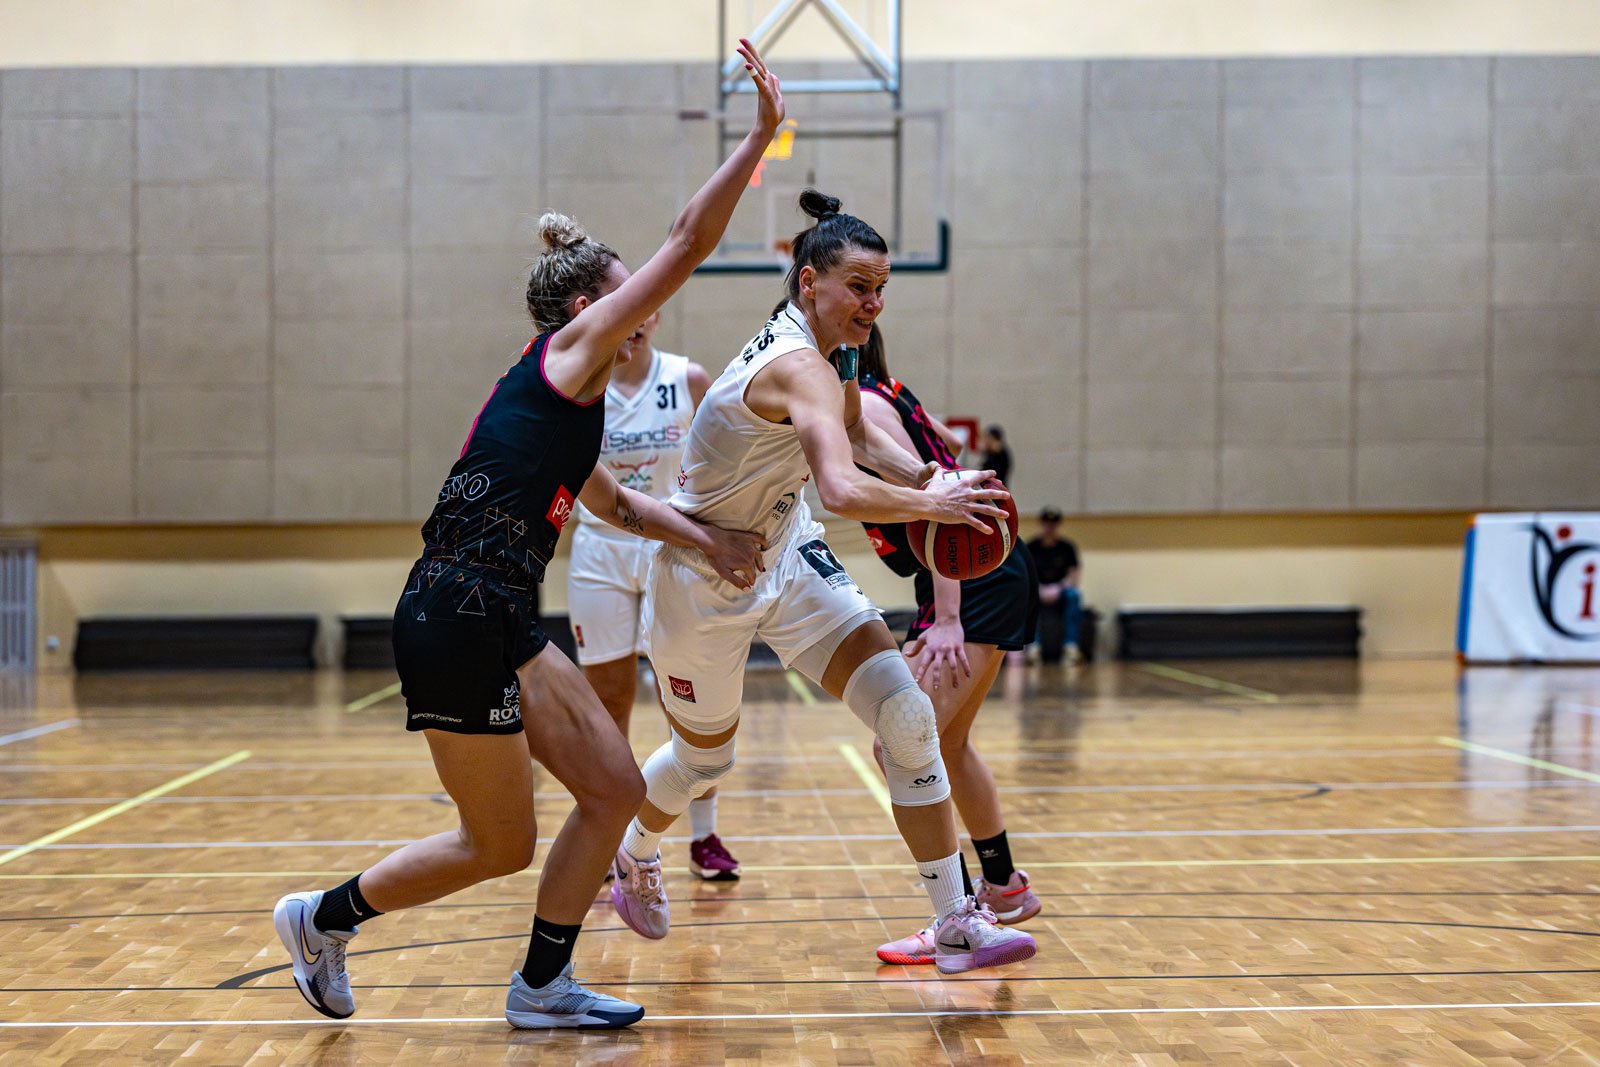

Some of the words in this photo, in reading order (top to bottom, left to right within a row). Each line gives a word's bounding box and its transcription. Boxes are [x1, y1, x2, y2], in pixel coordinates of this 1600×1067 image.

[657, 384, 677, 409] 31
[603, 425, 681, 450] iSandS
[773, 500, 787, 514] JEL
[947, 536, 958, 574] molten
[978, 544, 988, 566] FIBA
